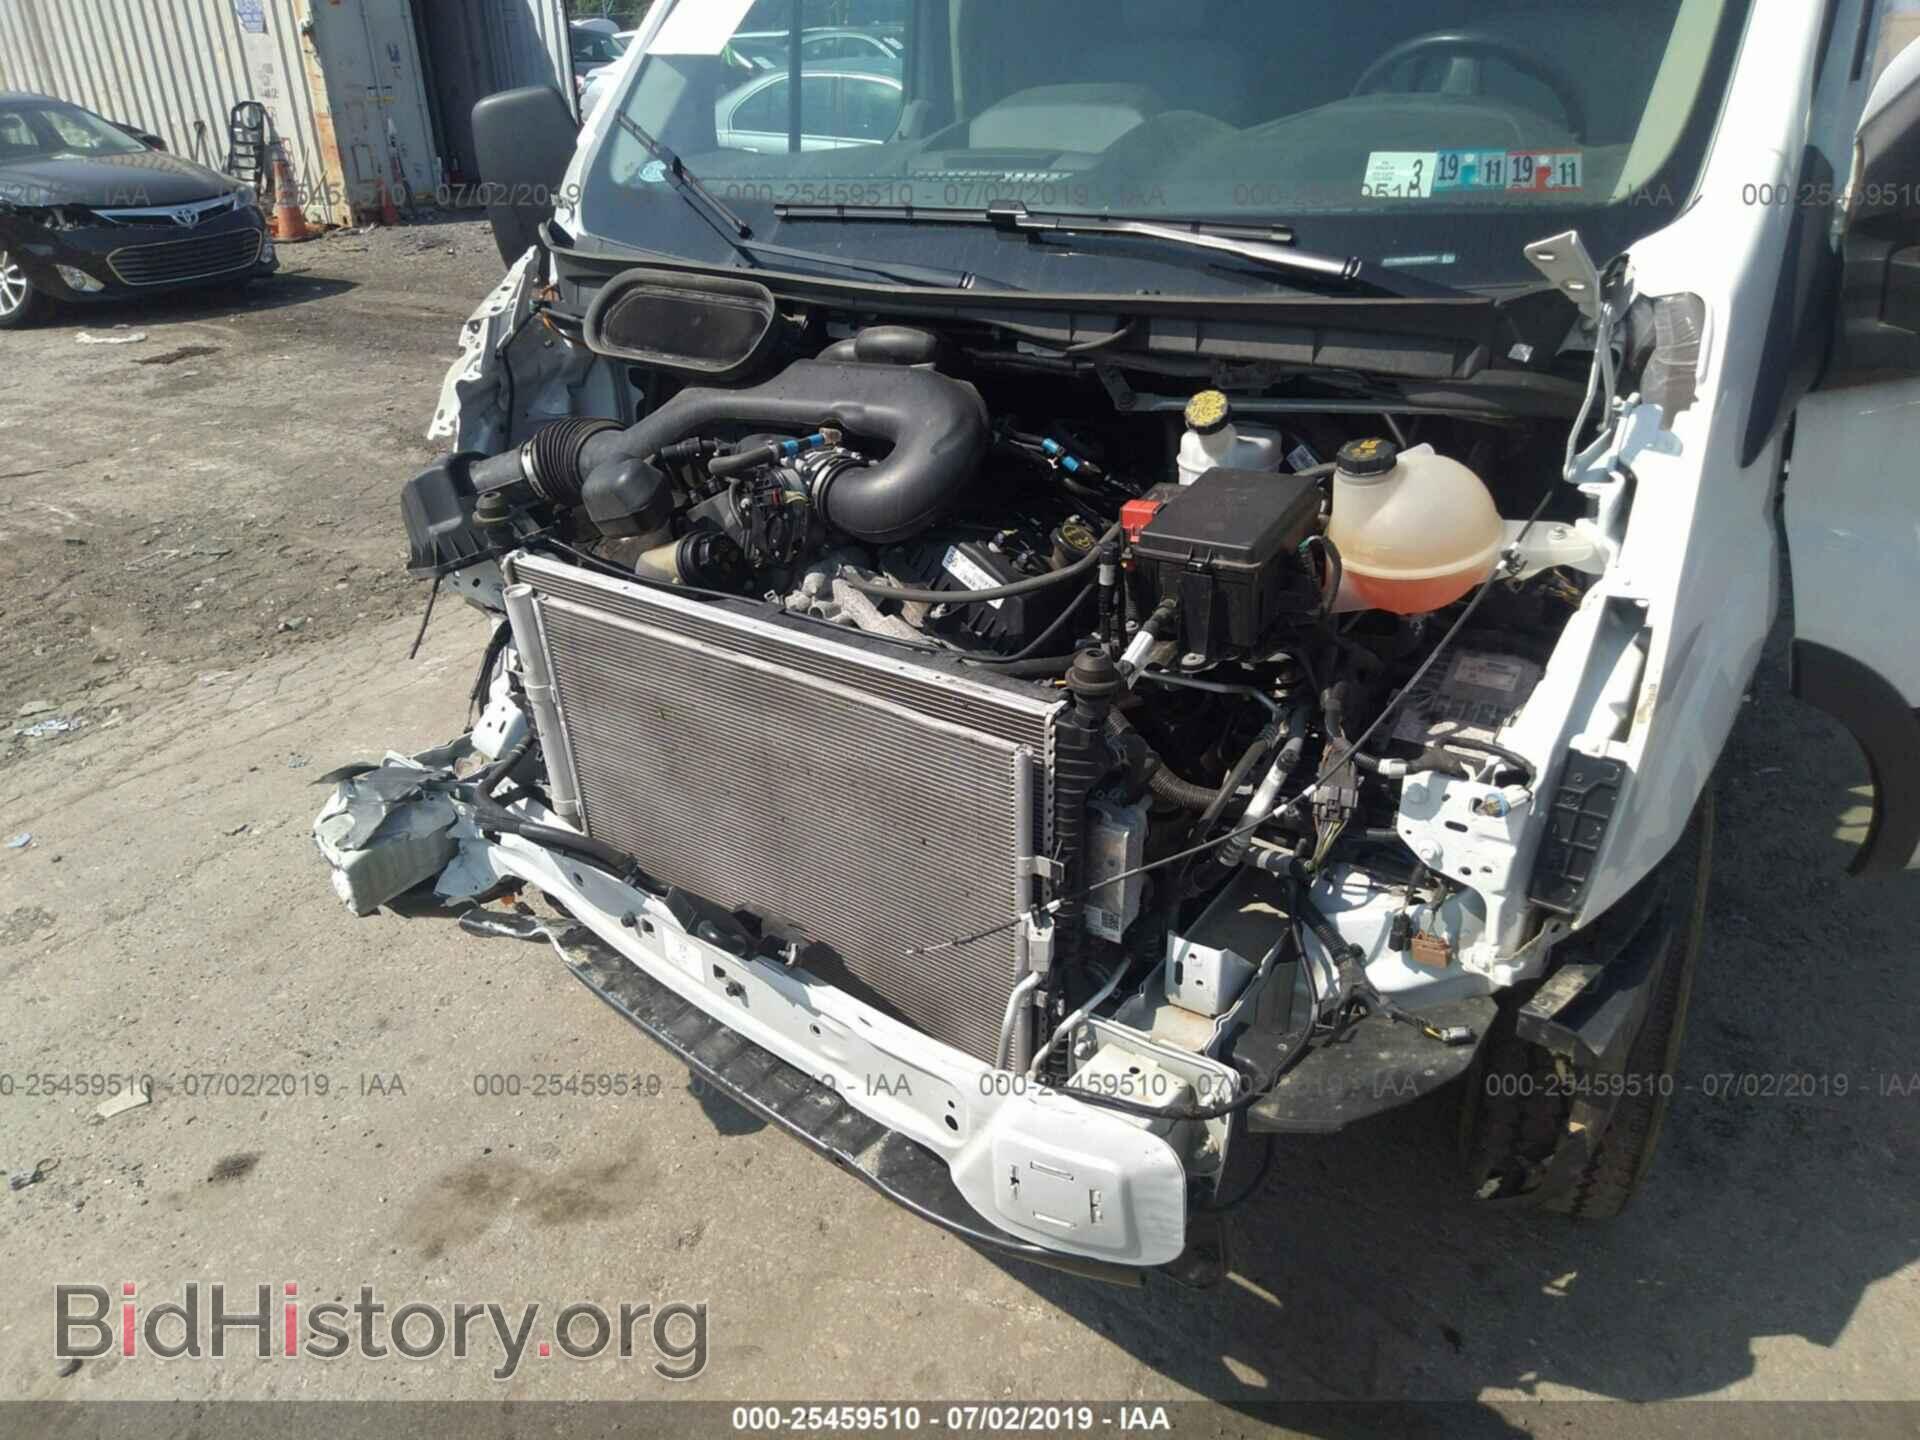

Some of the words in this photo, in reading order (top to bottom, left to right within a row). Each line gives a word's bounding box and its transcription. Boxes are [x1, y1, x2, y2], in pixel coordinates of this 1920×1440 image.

[1409, 158, 1424, 189] 3
[1438, 154, 1459, 181] 19
[1485, 160, 1502, 183] 11
[1512, 155, 1533, 182] 19
[1559, 161, 1577, 185] 11
